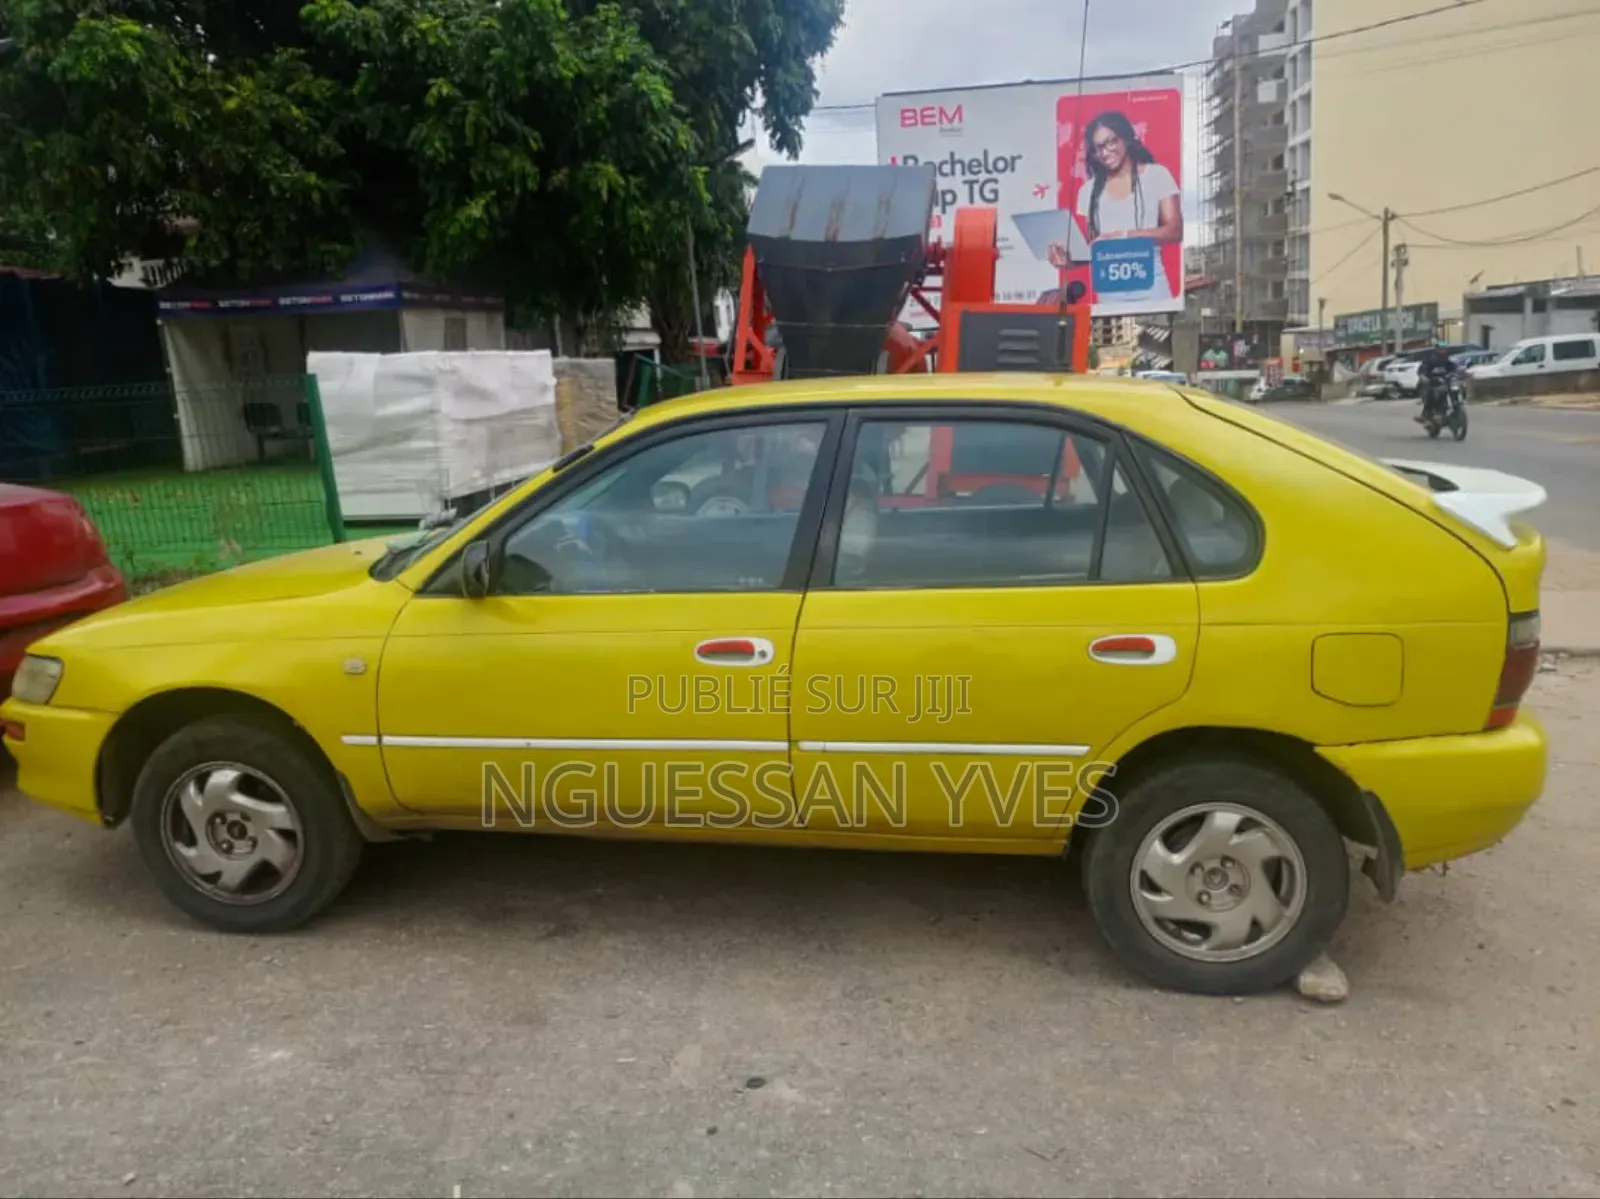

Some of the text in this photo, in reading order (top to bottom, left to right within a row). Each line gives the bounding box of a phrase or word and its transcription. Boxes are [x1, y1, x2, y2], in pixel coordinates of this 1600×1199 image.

[900, 104, 963, 128] BEM
[962, 178, 999, 205] TG
[1108, 261, 1147, 281] 50%
